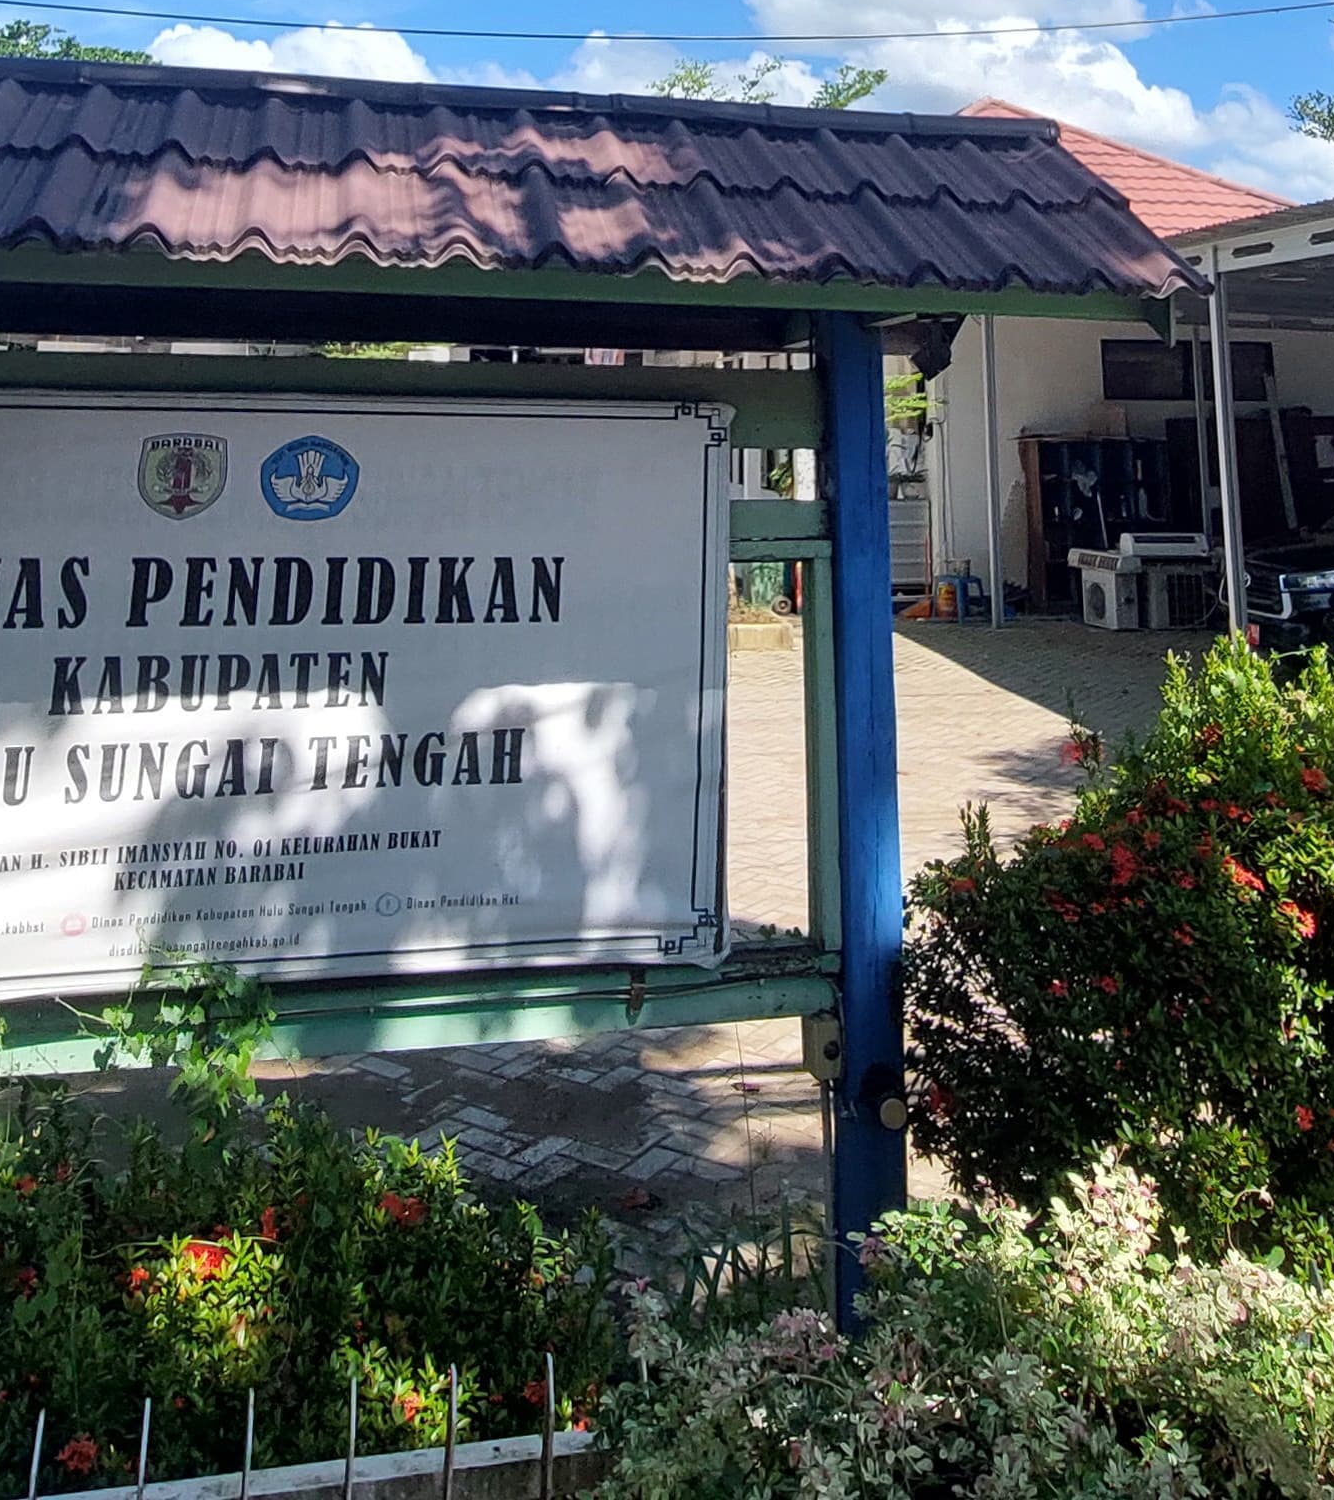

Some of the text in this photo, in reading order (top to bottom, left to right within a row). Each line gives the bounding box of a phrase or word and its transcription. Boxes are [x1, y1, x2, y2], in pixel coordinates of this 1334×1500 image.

[125, 556, 565, 628] PENDIDIKAN
[47, 651, 390, 717] KABUPATEN
[64, 737, 279, 805] SUNGAI
[308, 727, 527, 792] TENGAH
[30, 852, 50, 870] H.
[59, 847, 109, 868] SIBLI
[116, 840, 208, 864] IMANSYAH
[213, 840, 245, 860] NO.
[253, 838, 272, 858] 01
[280, 833, 380, 856] KELURAHAN
[387, 829, 442, 850] BUKAT
[113, 862, 305, 892] KECAMATAN BARABAI
[91, 899, 368, 929] Dinas Pendidikan Kabupaten Hulu Sungai Tengah
[405, 896, 436, 910] Dinas
[440, 893, 498, 908] Pendidikan
